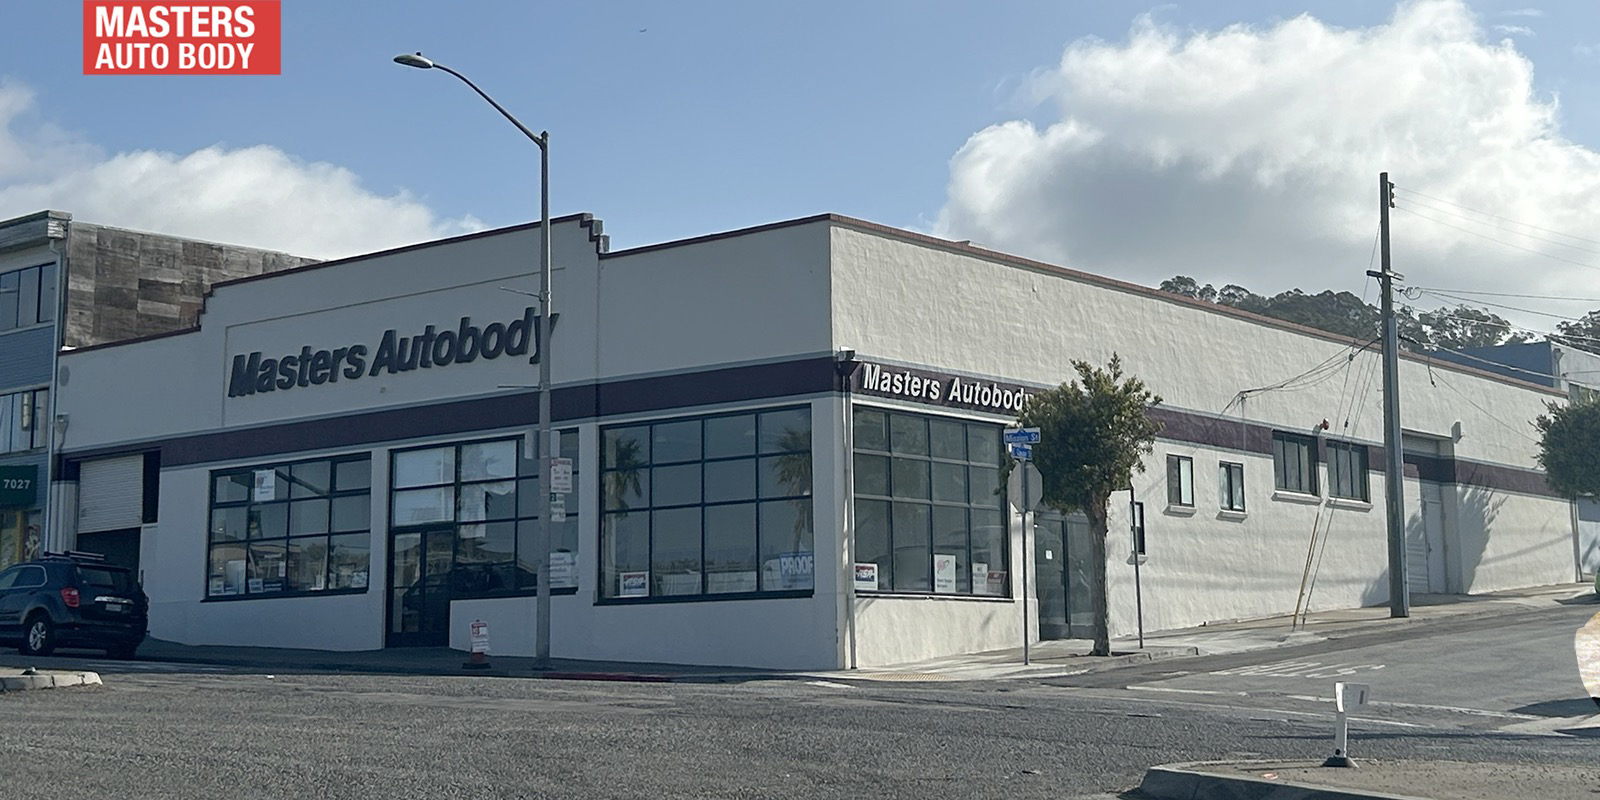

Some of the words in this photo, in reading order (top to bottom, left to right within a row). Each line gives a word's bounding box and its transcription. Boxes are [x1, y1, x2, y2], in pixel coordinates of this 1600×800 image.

[228, 344, 368, 398] Masters
[368, 307, 560, 376] Autobody
[863, 362, 942, 400] Masters
[1005, 433, 1030, 443] Mission
[1030, 431, 1039, 441] St
[3, 479, 31, 489] 7027
[780, 555, 814, 576] PROOF
